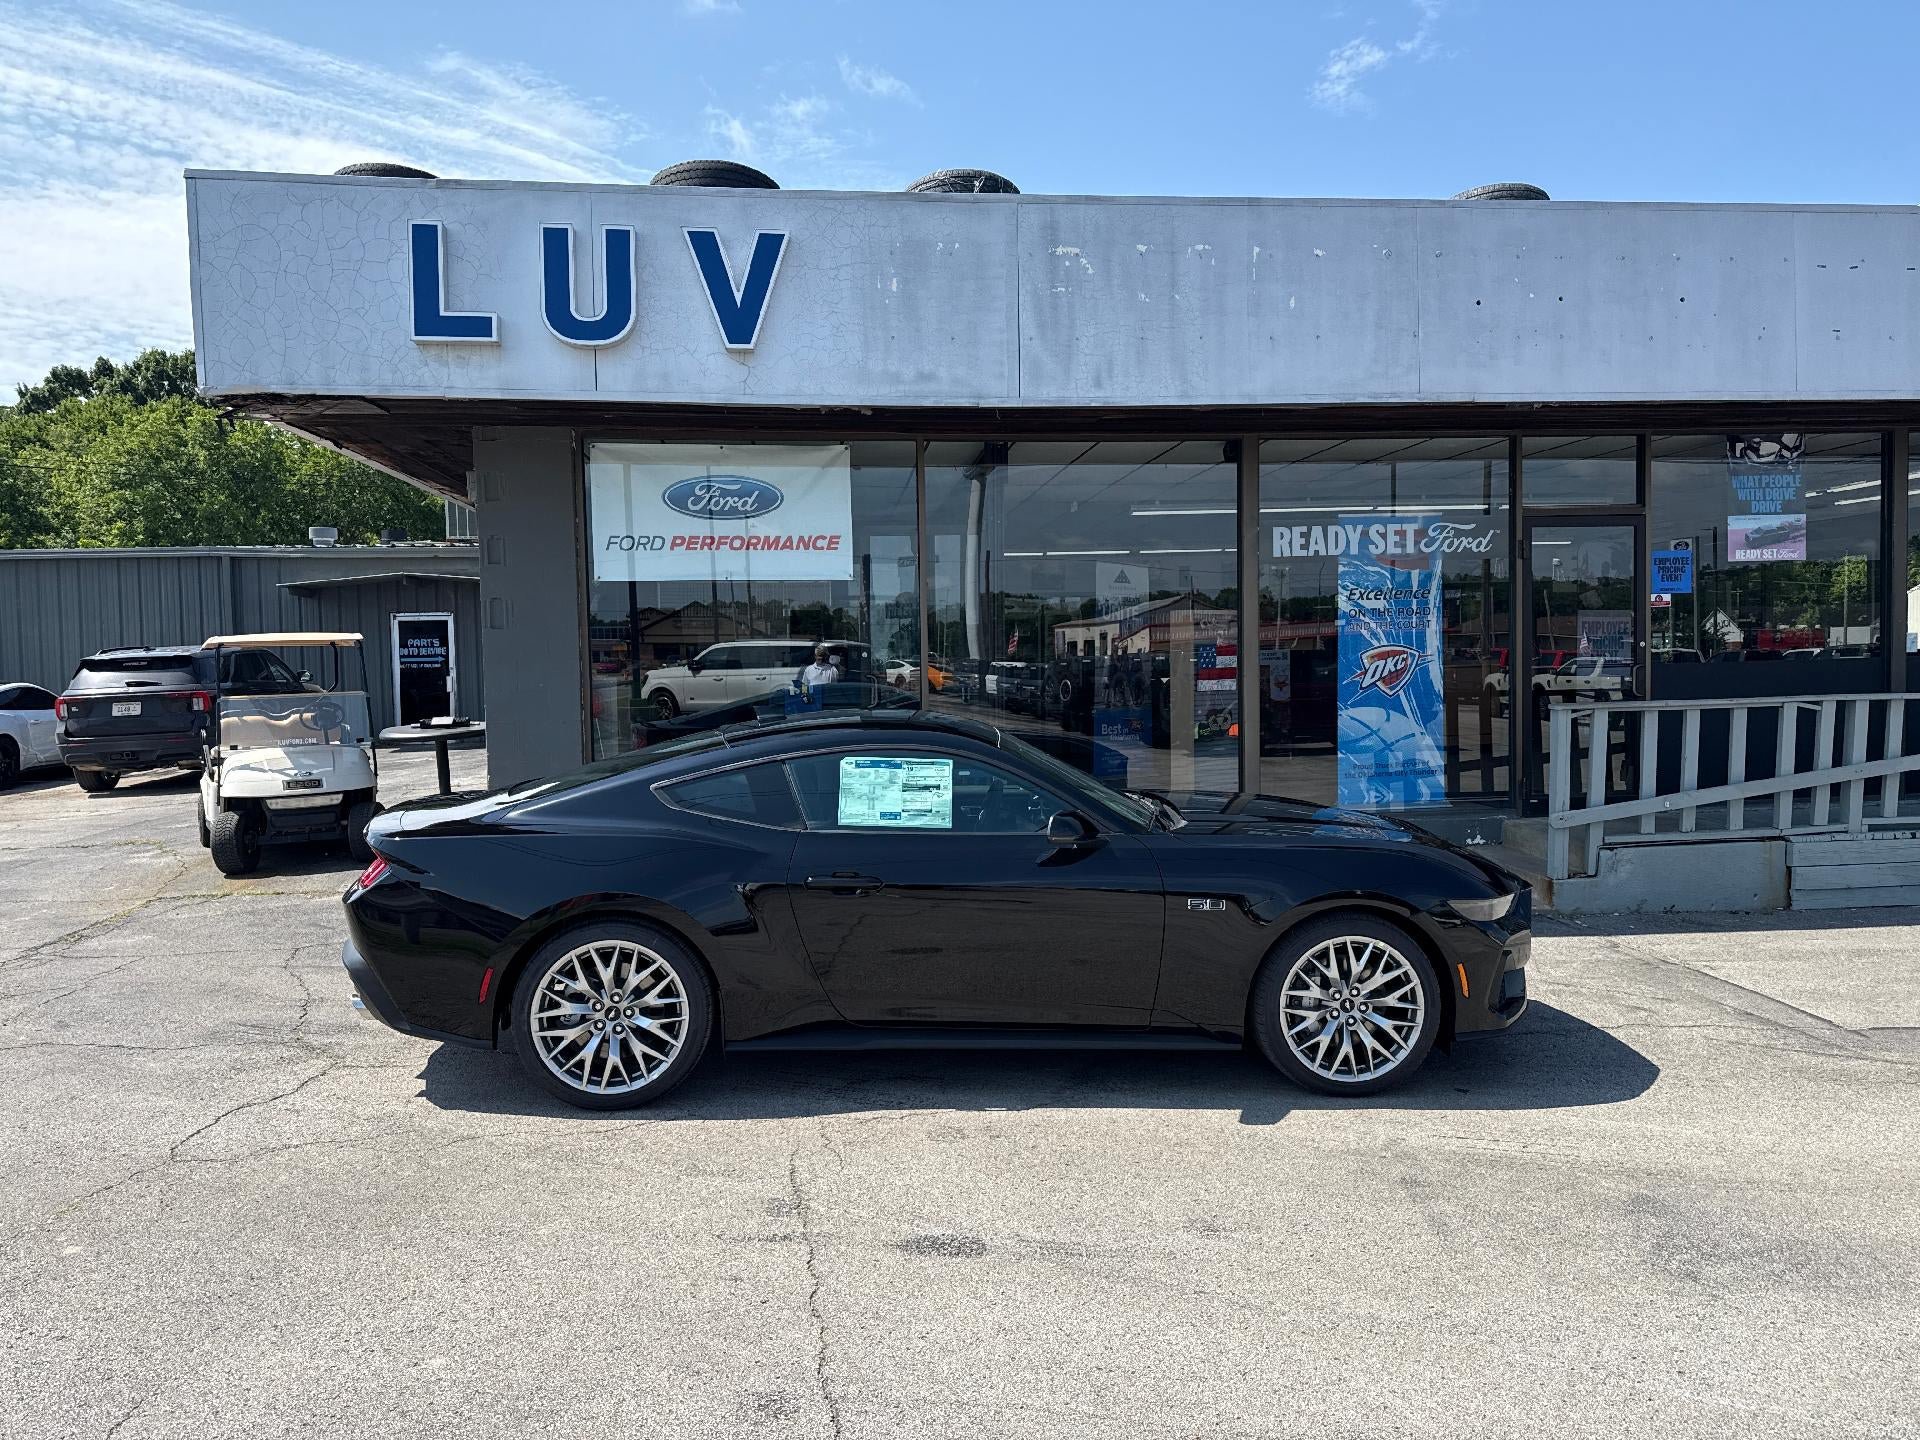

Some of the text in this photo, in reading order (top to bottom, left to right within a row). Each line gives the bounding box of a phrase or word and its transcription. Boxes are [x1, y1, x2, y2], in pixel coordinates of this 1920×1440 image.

[1732, 474, 1801, 488] WHAT PEOPLE
[687, 482, 760, 511] Ford
[1737, 488, 1796, 500] WITH DRIVE
[1752, 501, 1782, 513] DRIVE
[606, 535, 841, 551] FORD PERFORMANCE
[1272, 522, 1494, 557] READY SET Ford
[1735, 548, 1800, 559] READY SET Ford
[1653, 557, 1690, 566] EMPLOYEE
[1657, 565, 1686, 574] PRICING
[1661, 574, 1682, 582] EVENT
[1349, 588, 1431, 601] Excellence
[1349, 607, 1431, 618] ON THE ROAD
[1349, 619, 1431, 631] AND THE COURT
[1582, 620, 1629, 635] EMPLOYEE
[407, 638, 440, 647] PARTS
[1360, 653, 1408, 690] OKC
[1101, 723, 1122, 735] Best
